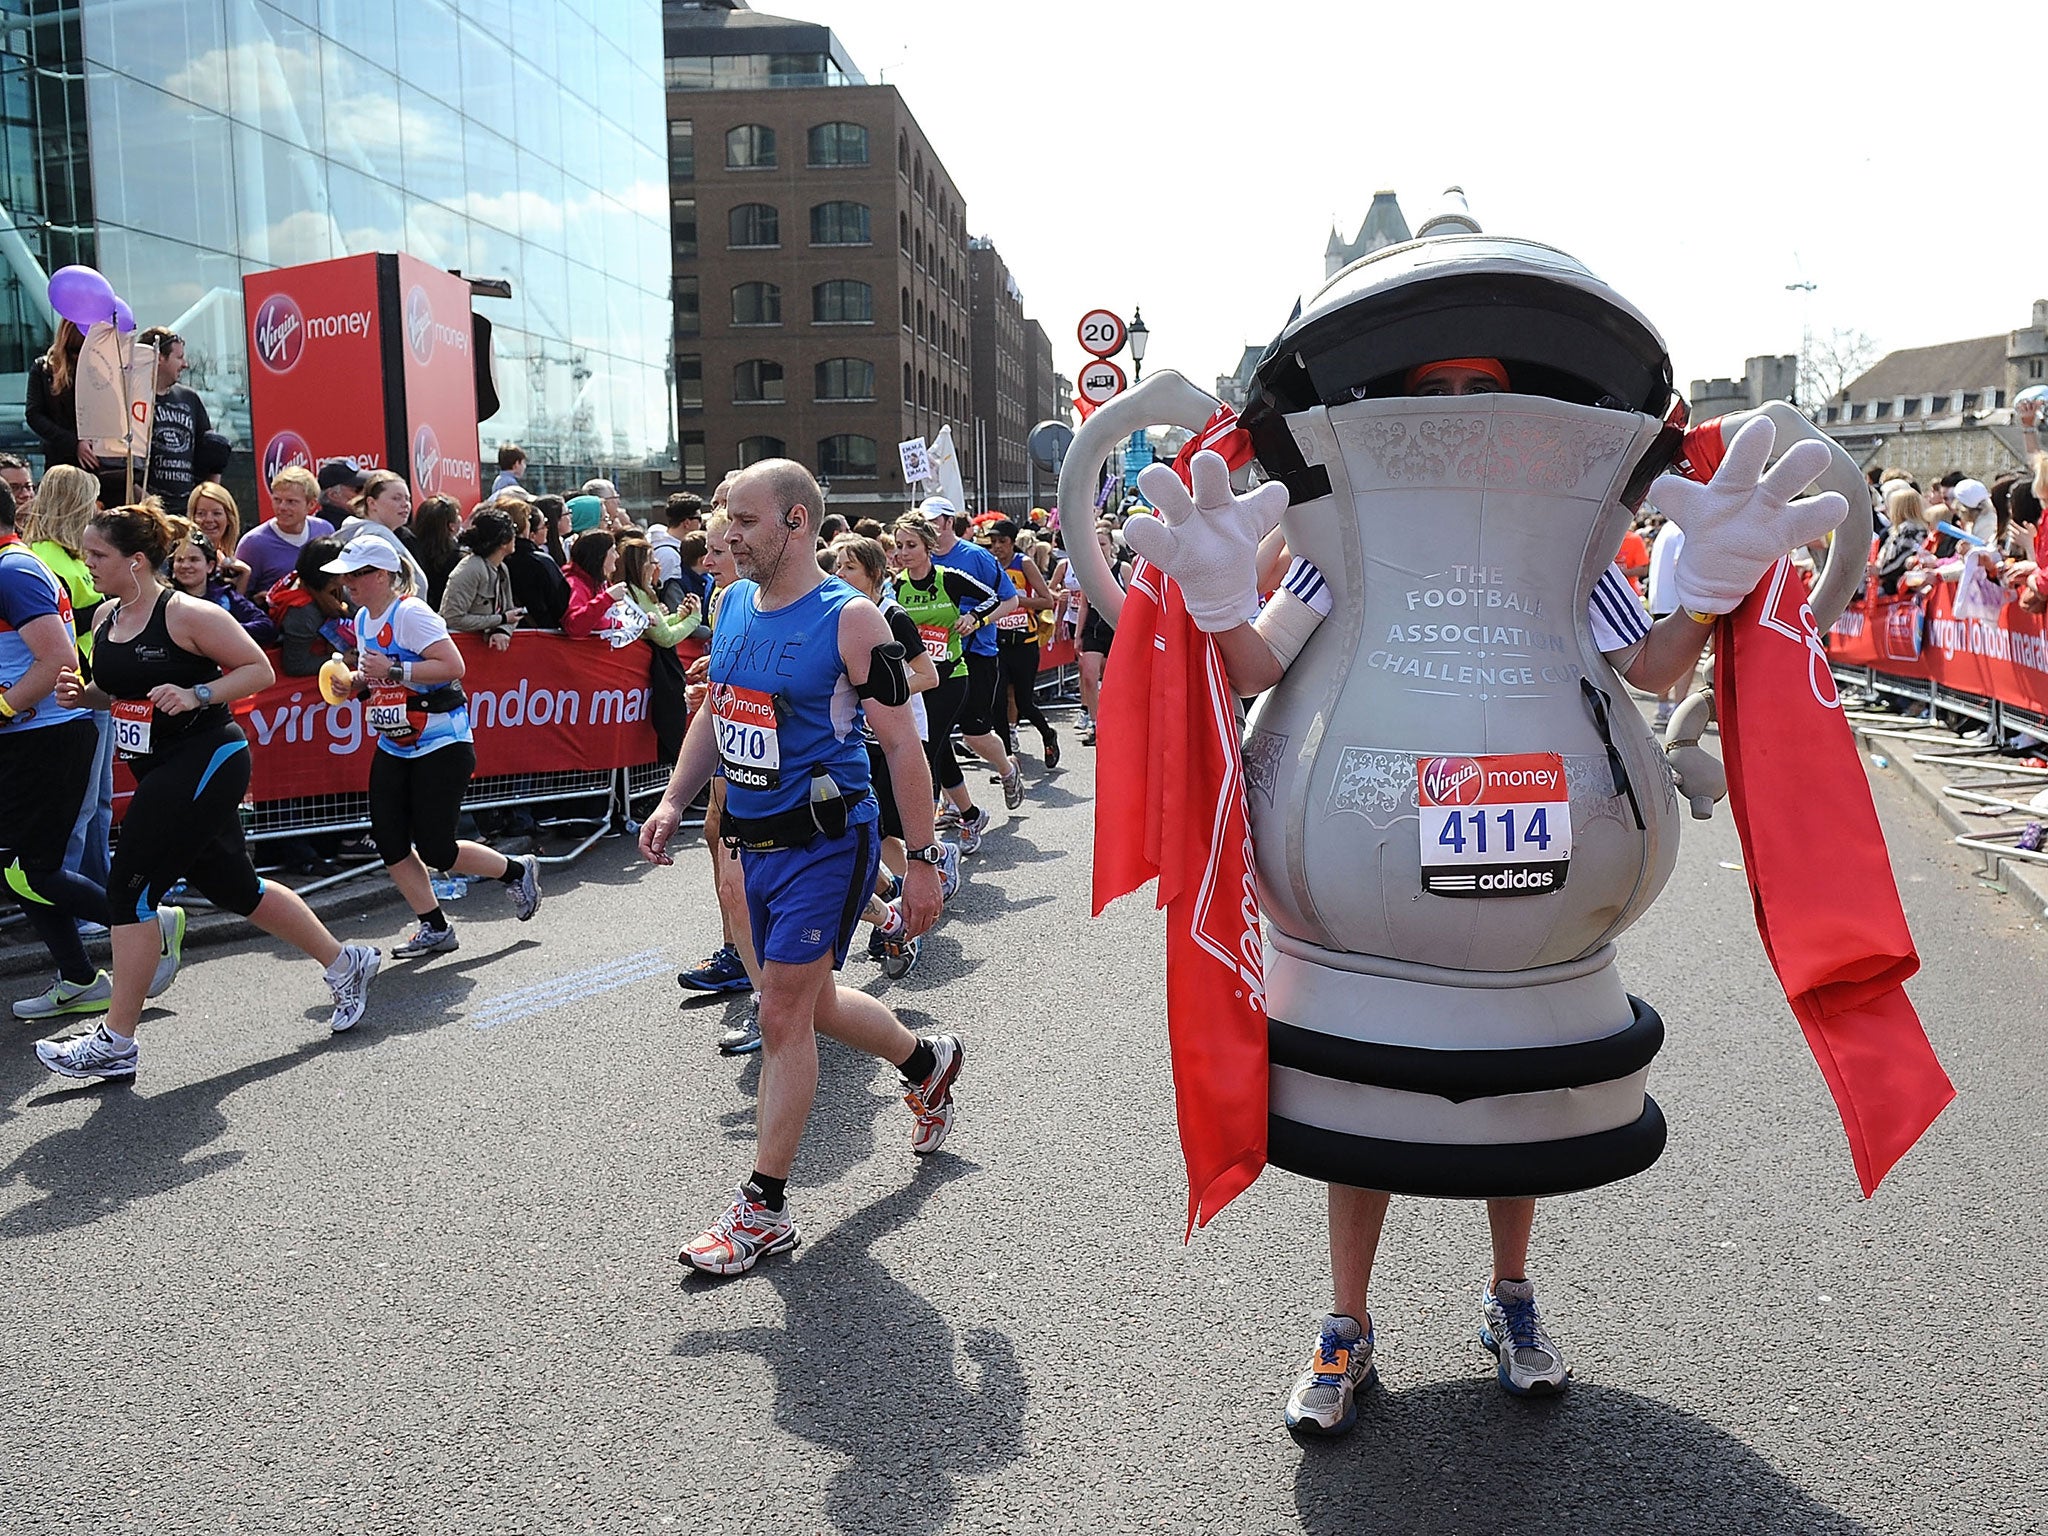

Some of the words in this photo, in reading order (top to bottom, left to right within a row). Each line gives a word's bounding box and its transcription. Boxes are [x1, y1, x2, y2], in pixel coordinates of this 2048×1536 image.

[259, 305, 300, 361] Virgin
[306, 310, 371, 339] money
[407, 296, 432, 353] Virgin
[434, 322, 469, 356] money
[1085, 324, 1114, 341] 20
[902, 443, 923, 454] EMMA
[416, 436, 439, 491] Virgin
[442, 457, 476, 486] money
[907, 467, 927, 477] EMMA
[1452, 565, 1503, 584] THE
[905, 593, 937, 604] FRED
[1406, 588, 1544, 618] FOOTBALL
[1386, 624, 1566, 652] ASSOCIATION
[1929, 610, 1966, 661] virgin
[2011, 629, 2048, 674] marat
[923, 642, 945, 658] 92
[1367, 650, 1535, 686] CHALLENGE
[119, 702, 150, 717] money
[250, 692, 376, 755] virg
[470, 679, 577, 728] ndon
[370, 707, 400, 725] 3690
[736, 699, 775, 720] money
[728, 768, 768, 787] adidas
[1427, 758, 1478, 802] Virgin
[1488, 770, 1558, 790] money
[1439, 808, 1551, 854] 4114
[1562, 850, 1568, 858] 2
[1479, 869, 1554, 890] adidas
